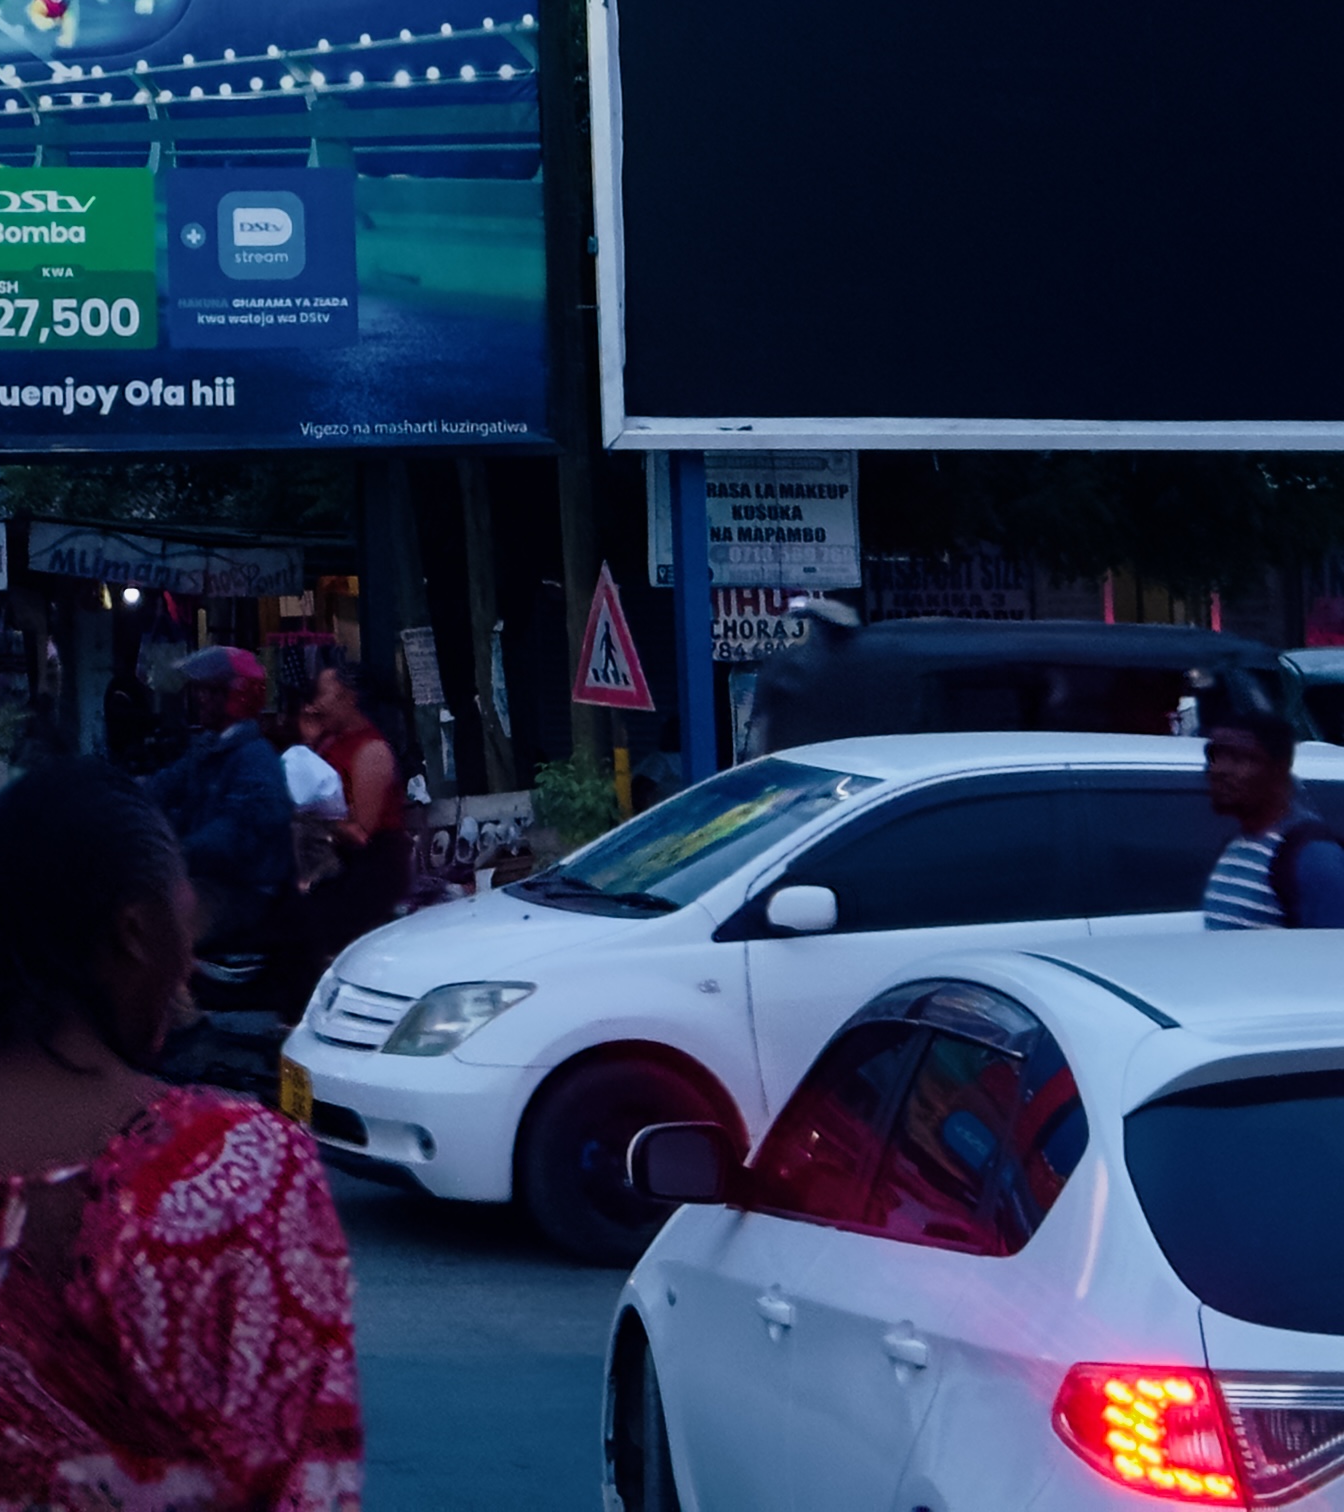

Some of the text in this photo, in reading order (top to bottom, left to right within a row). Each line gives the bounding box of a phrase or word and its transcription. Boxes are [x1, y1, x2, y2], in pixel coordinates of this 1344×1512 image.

[239, 222, 285, 233] DStv
[234, 250, 289, 263] stream
[42, 267, 74, 277] KWA
[178, 297, 349, 308] HAKUNA GHARAMA YA ZIADA
[197, 312, 330, 326] kwa wateja wa DStv
[124, 377, 186, 407] Ofa
[192, 376, 235, 407] hii
[300, 418, 528, 439] Vigezo na masharti kuzingatiwa
[706, 482, 849, 500] RASA LA MAKEUP
[732, 504, 803, 521] KUSUKA
[710, 526, 826, 543] NA MAPAMBO
